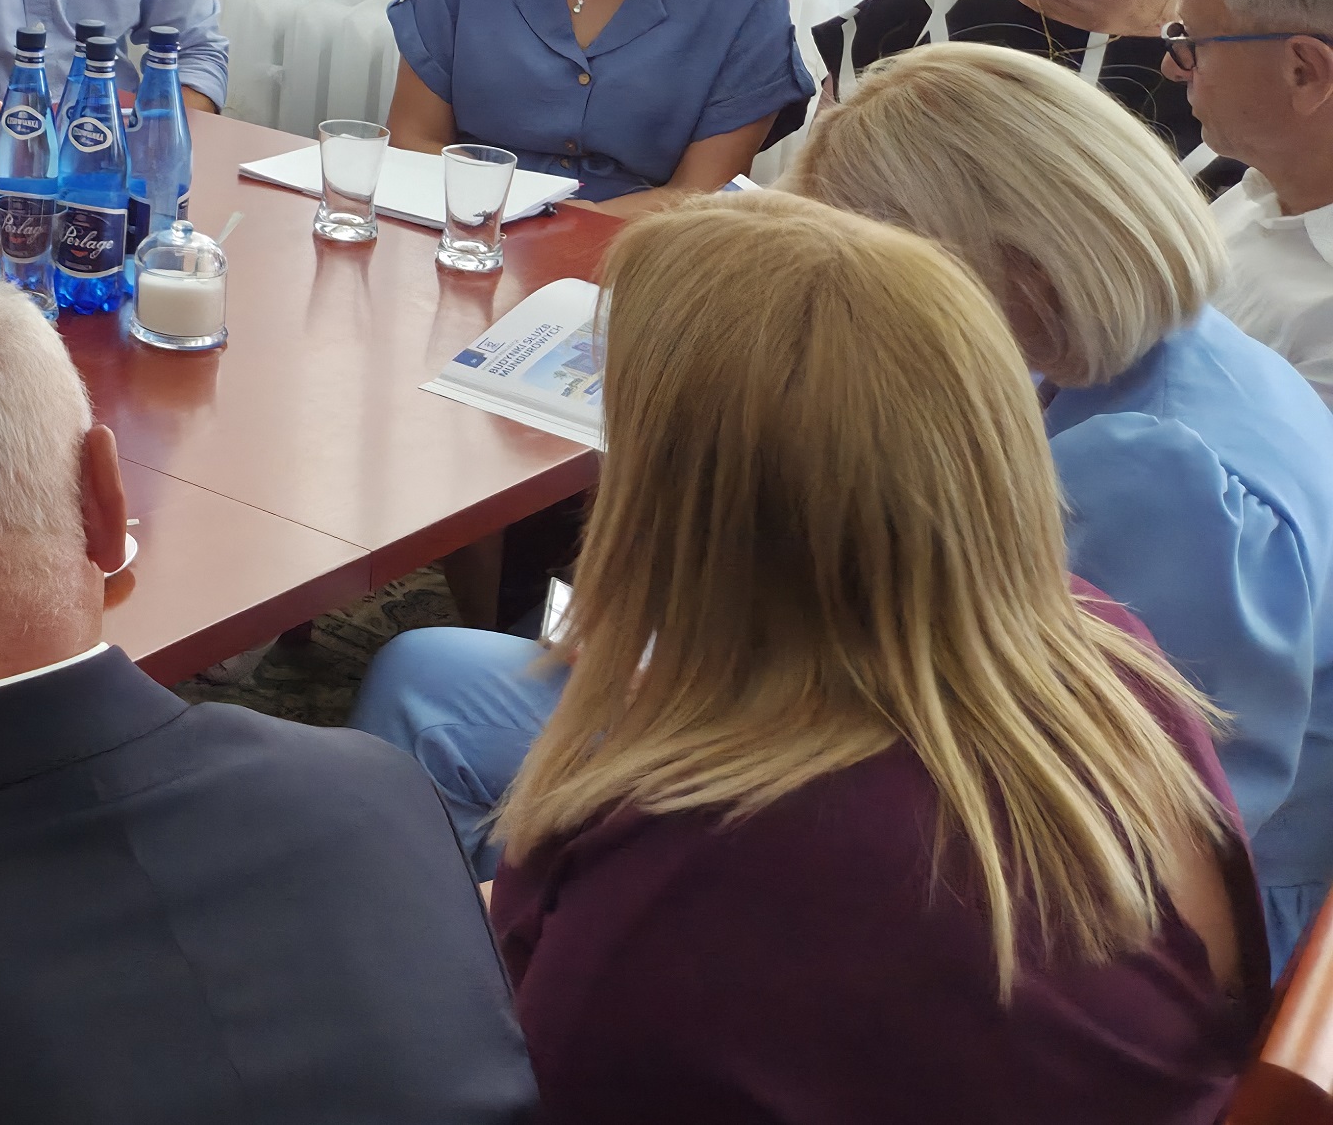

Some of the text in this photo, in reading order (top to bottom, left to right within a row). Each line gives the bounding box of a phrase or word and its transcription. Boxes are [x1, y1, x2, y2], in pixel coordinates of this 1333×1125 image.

[61, 225, 114, 258] Perlage
[488, 342, 526, 375] BUDYNKI
[523, 323, 551, 345] SŁUŻB
[498, 325, 563, 377] MUNDUROWYCH
